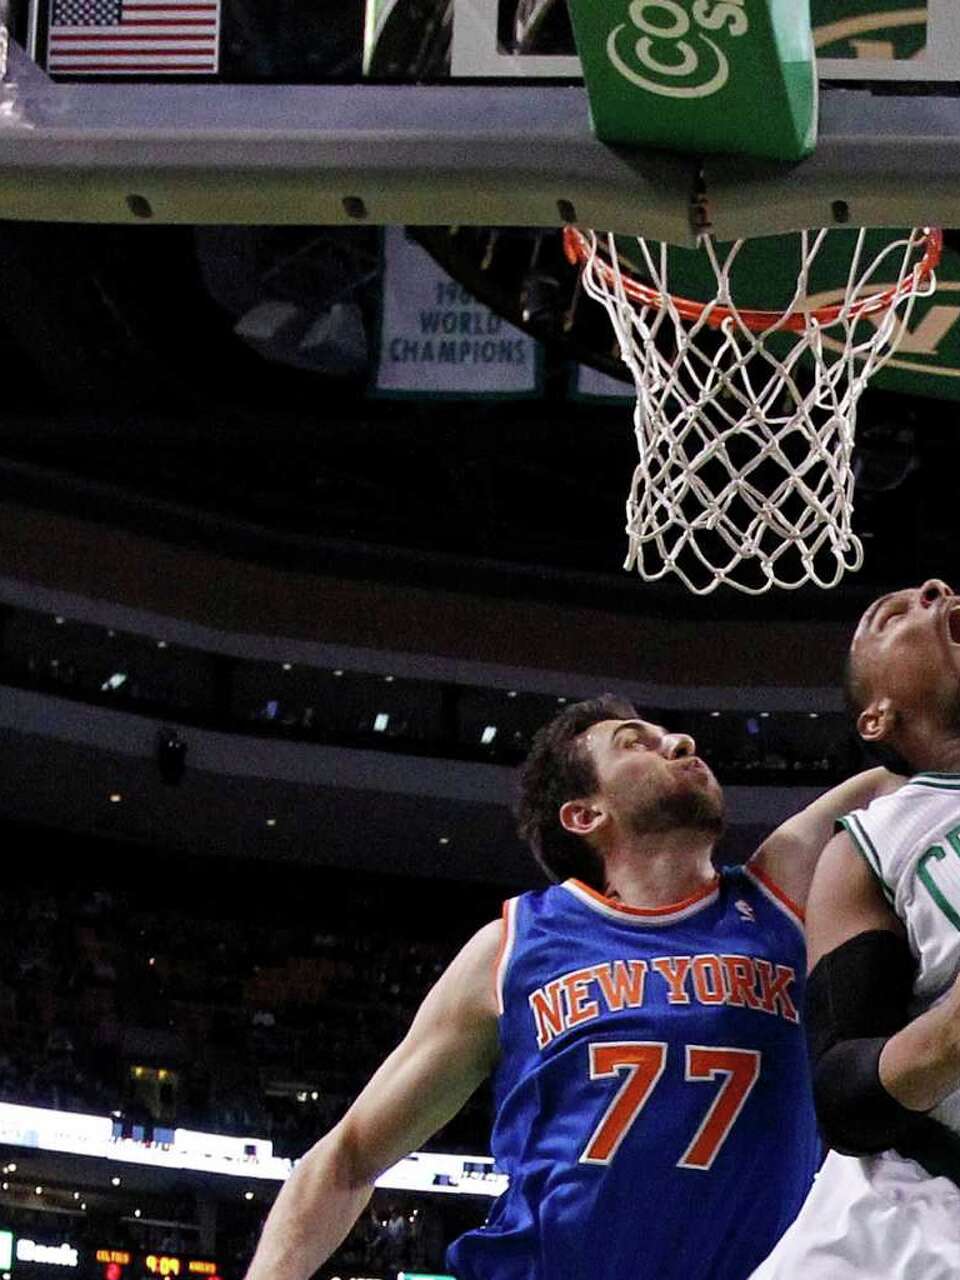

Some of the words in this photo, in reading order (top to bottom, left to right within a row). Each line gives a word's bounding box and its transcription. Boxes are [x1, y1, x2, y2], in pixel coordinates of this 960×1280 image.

[389, 337, 526, 364] CHAMPIONS
[528, 959, 648, 1049] NEW
[652, 954, 799, 1023] YORK
[579, 1041, 761, 1171] 77
